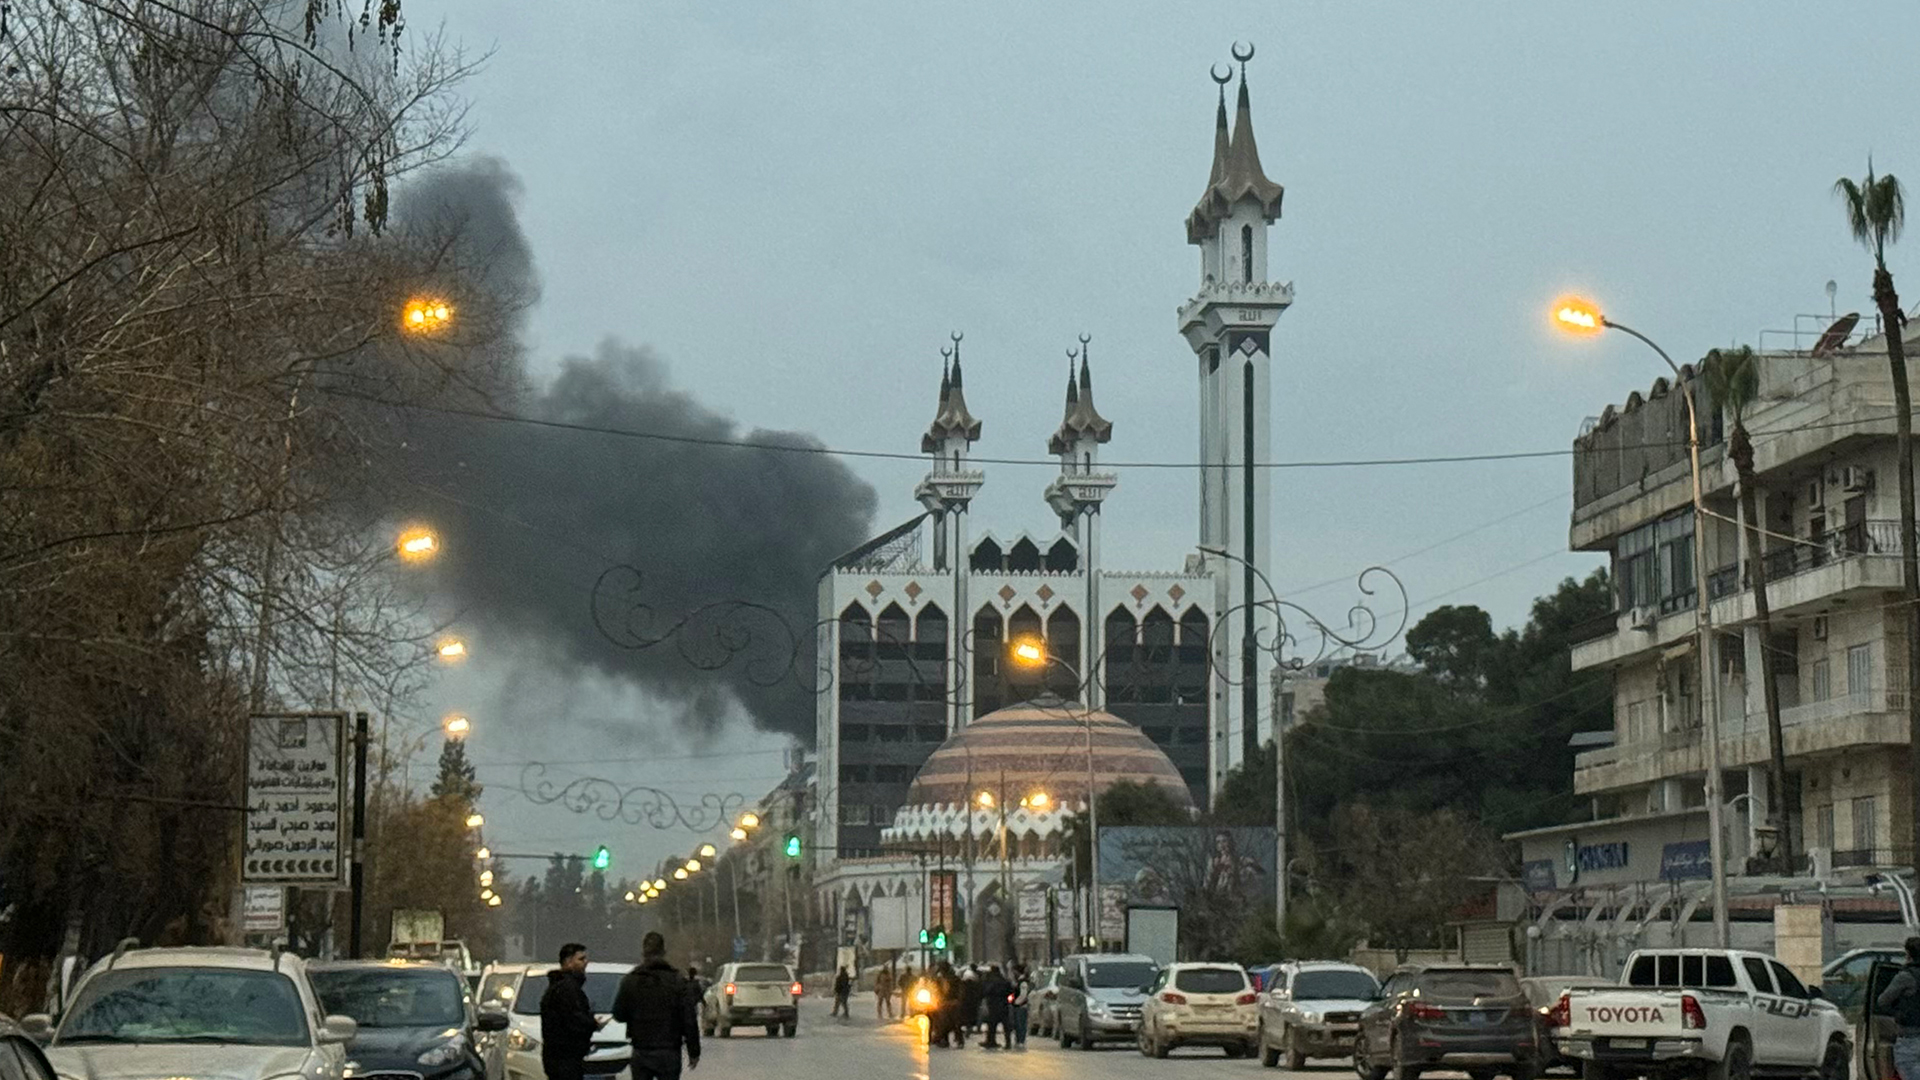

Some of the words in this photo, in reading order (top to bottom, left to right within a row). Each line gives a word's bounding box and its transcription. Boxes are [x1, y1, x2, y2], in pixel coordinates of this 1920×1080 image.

[1239, 310, 1262, 321] الله
[946, 485, 969, 497] الله
[1079, 487, 1101, 499] الله
[303, 802, 337, 815] محمود
[250, 817, 277, 833] السيد
[281, 821, 309, 836] صبحي
[313, 821, 335, 832] محمد
[287, 838, 317, 852] الرحمن
[320, 841, 336, 853] عبد
[1586, 1007, 1664, 1023] TOYOTA
